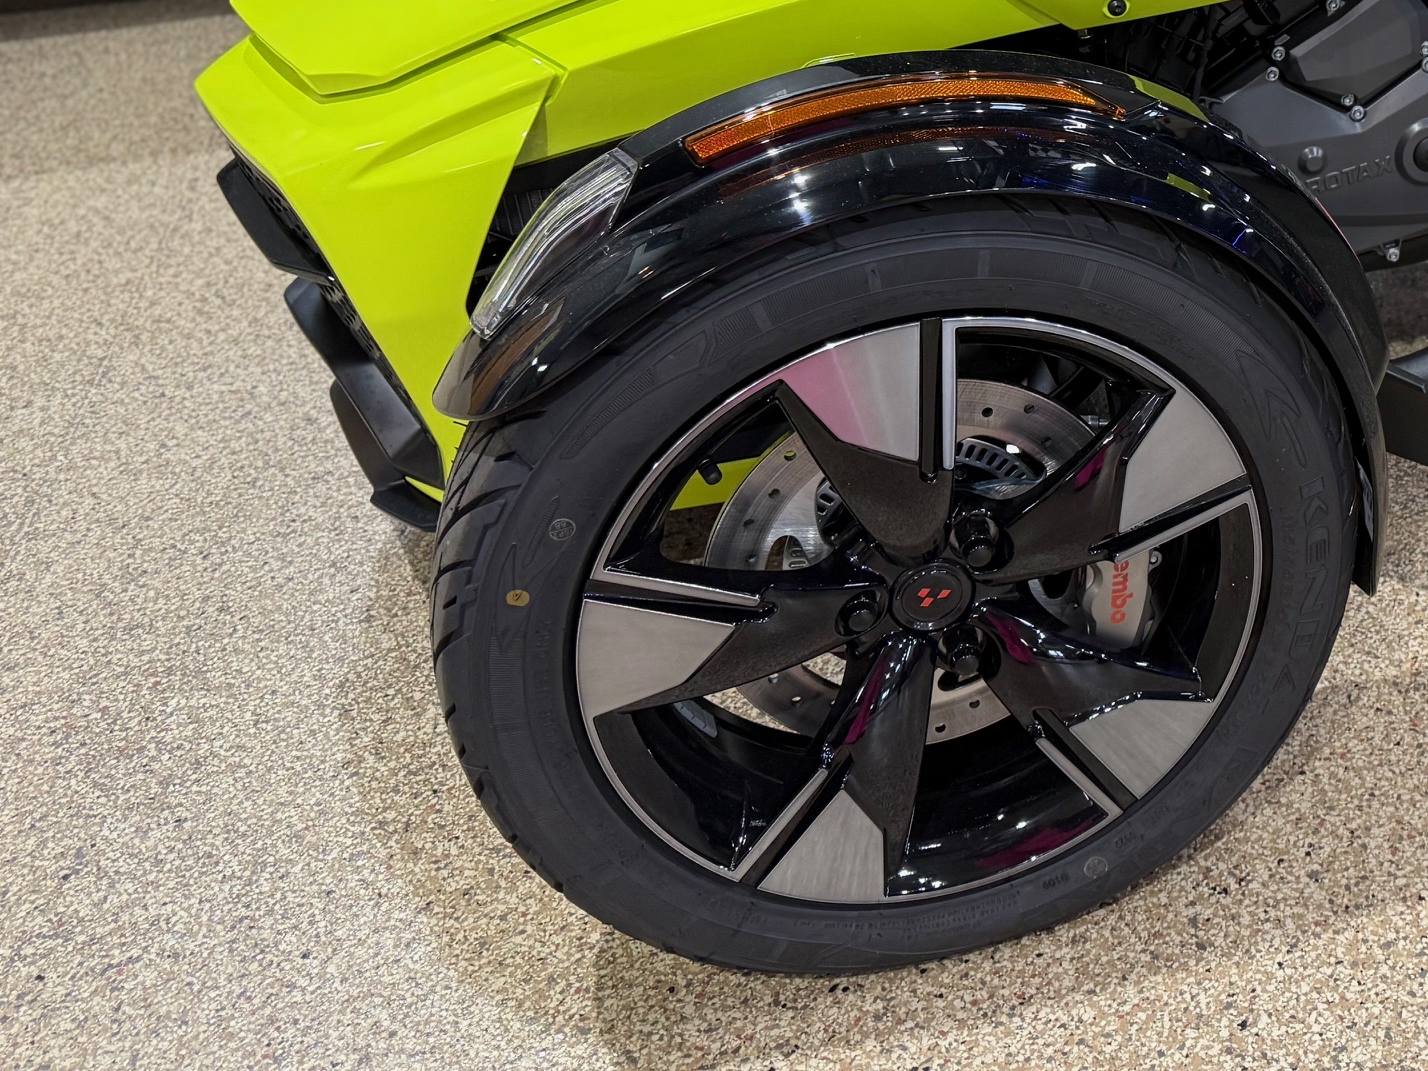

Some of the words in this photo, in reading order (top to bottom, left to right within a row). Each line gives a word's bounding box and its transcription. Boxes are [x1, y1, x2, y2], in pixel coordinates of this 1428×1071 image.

[1305, 155, 1394, 194] ROTAX
[1110, 559, 1134, 624] embo
[1259, 475, 1330, 715] KENDA
